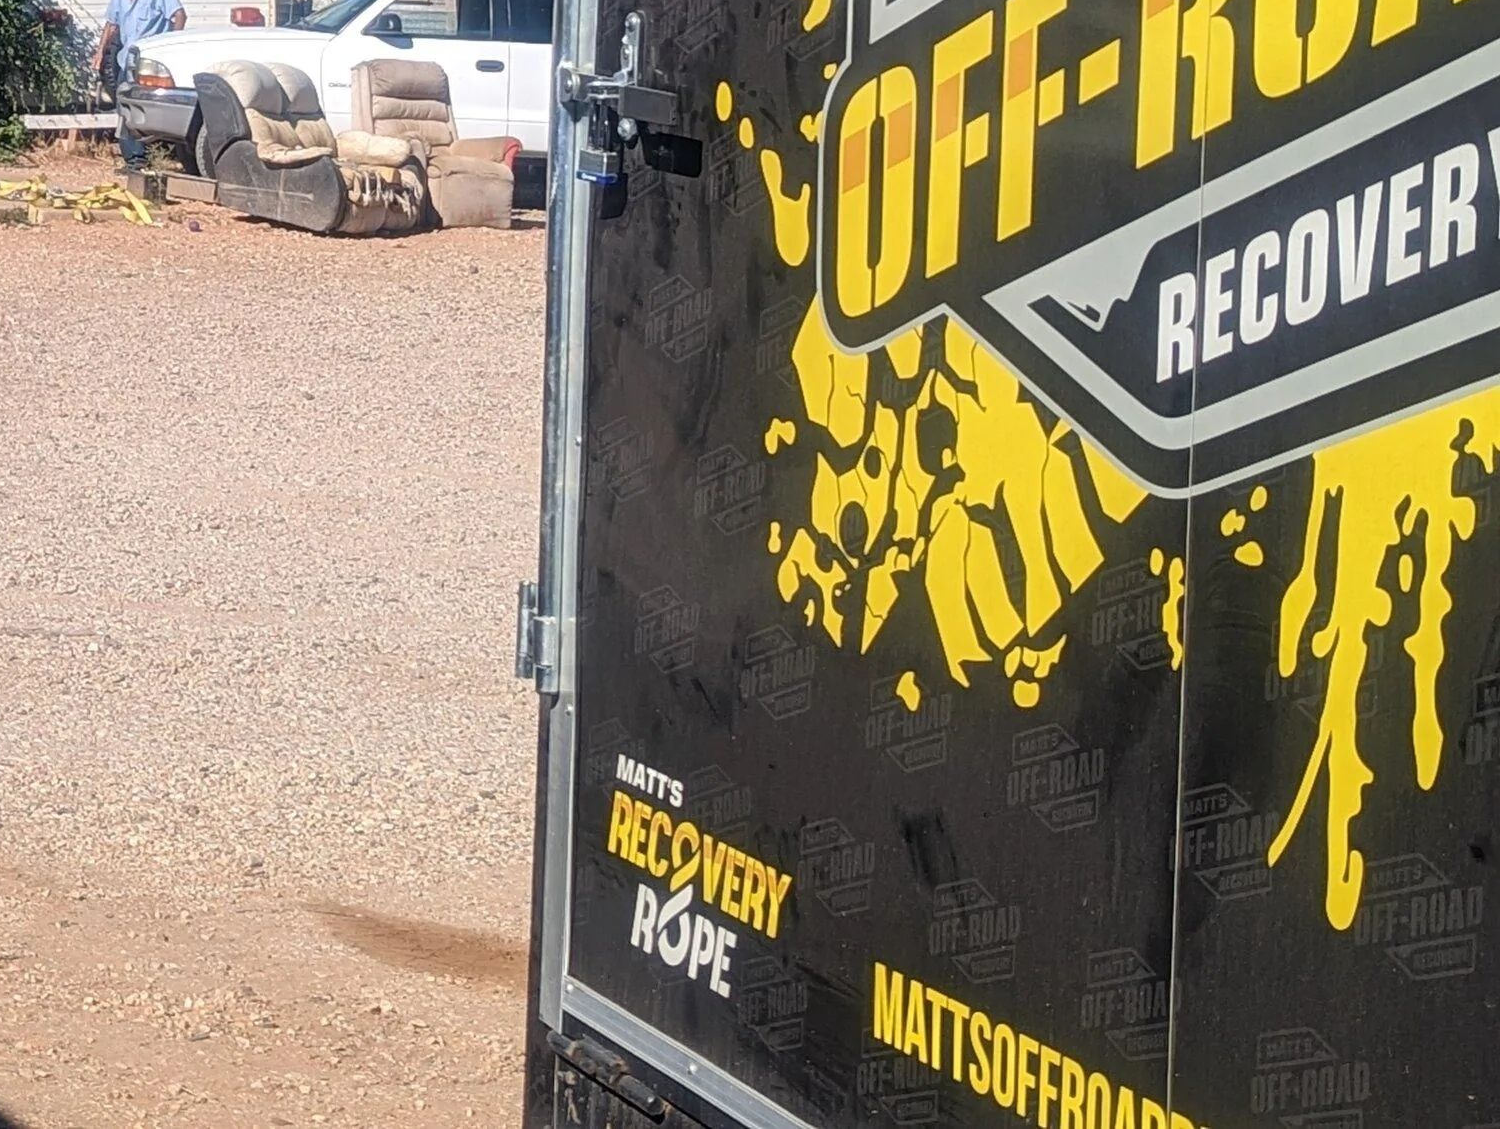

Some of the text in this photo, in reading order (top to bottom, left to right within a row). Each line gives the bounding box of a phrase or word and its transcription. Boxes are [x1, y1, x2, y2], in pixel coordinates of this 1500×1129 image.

[1156, 125, 1500, 385] RECOVER
[615, 754, 684, 809] MATT'S
[1006, 748, 1104, 806] OFF-ROAD
[607, 790, 793, 939] RECOVERY
[630, 882, 738, 999] ROPE
[1354, 885, 1484, 947] OFF-ROAD
